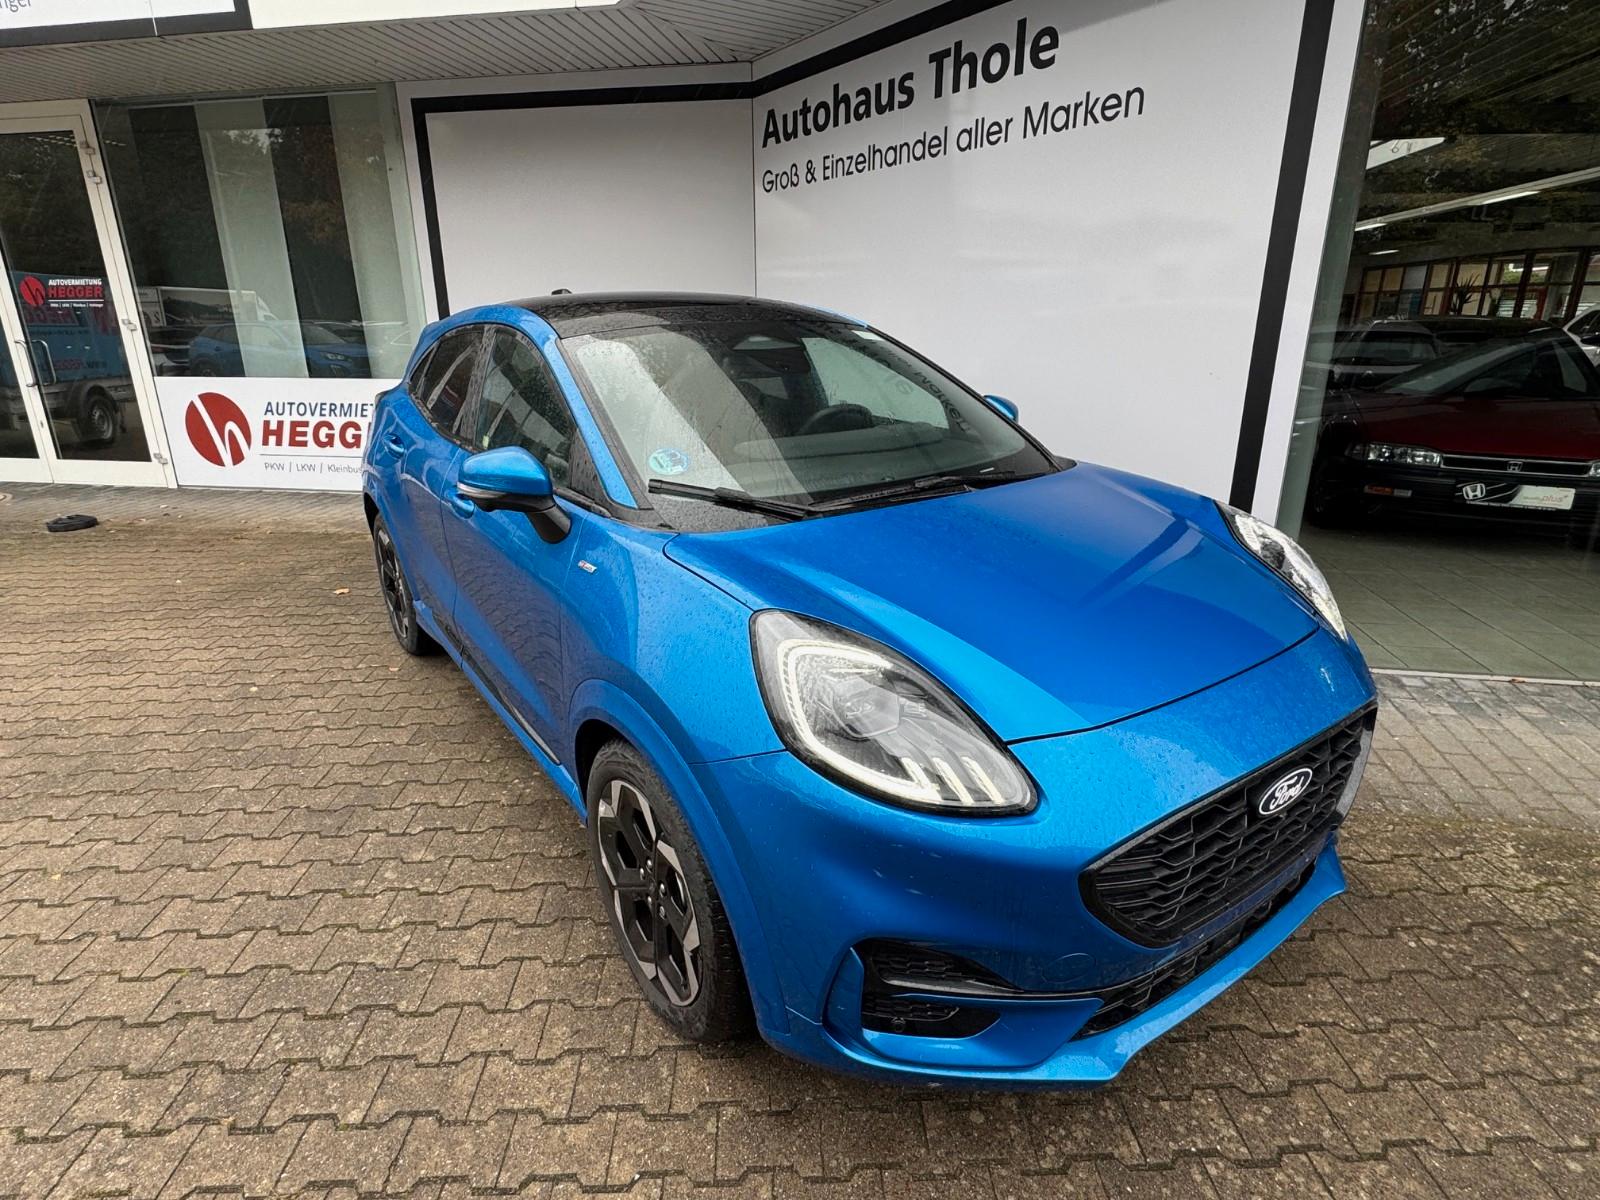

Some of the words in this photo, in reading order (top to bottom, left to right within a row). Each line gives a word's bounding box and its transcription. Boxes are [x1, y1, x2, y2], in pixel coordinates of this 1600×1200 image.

[762, 71, 915, 148] Autohaus
[928, 17, 1059, 98] Thole
[762, 163, 800, 193] Groß
[805, 159, 817, 184] &
[822, 126, 948, 181] Einzelhandel
[956, 117, 1014, 154] aller
[1022, 87, 1145, 139] Marken
[48, 286, 103, 298] HEGGER
[261, 420, 372, 448] HEGG
[264, 462, 285, 471] PKW
[296, 463, 316, 472] LKW
[1269, 776, 1305, 810] Ford
